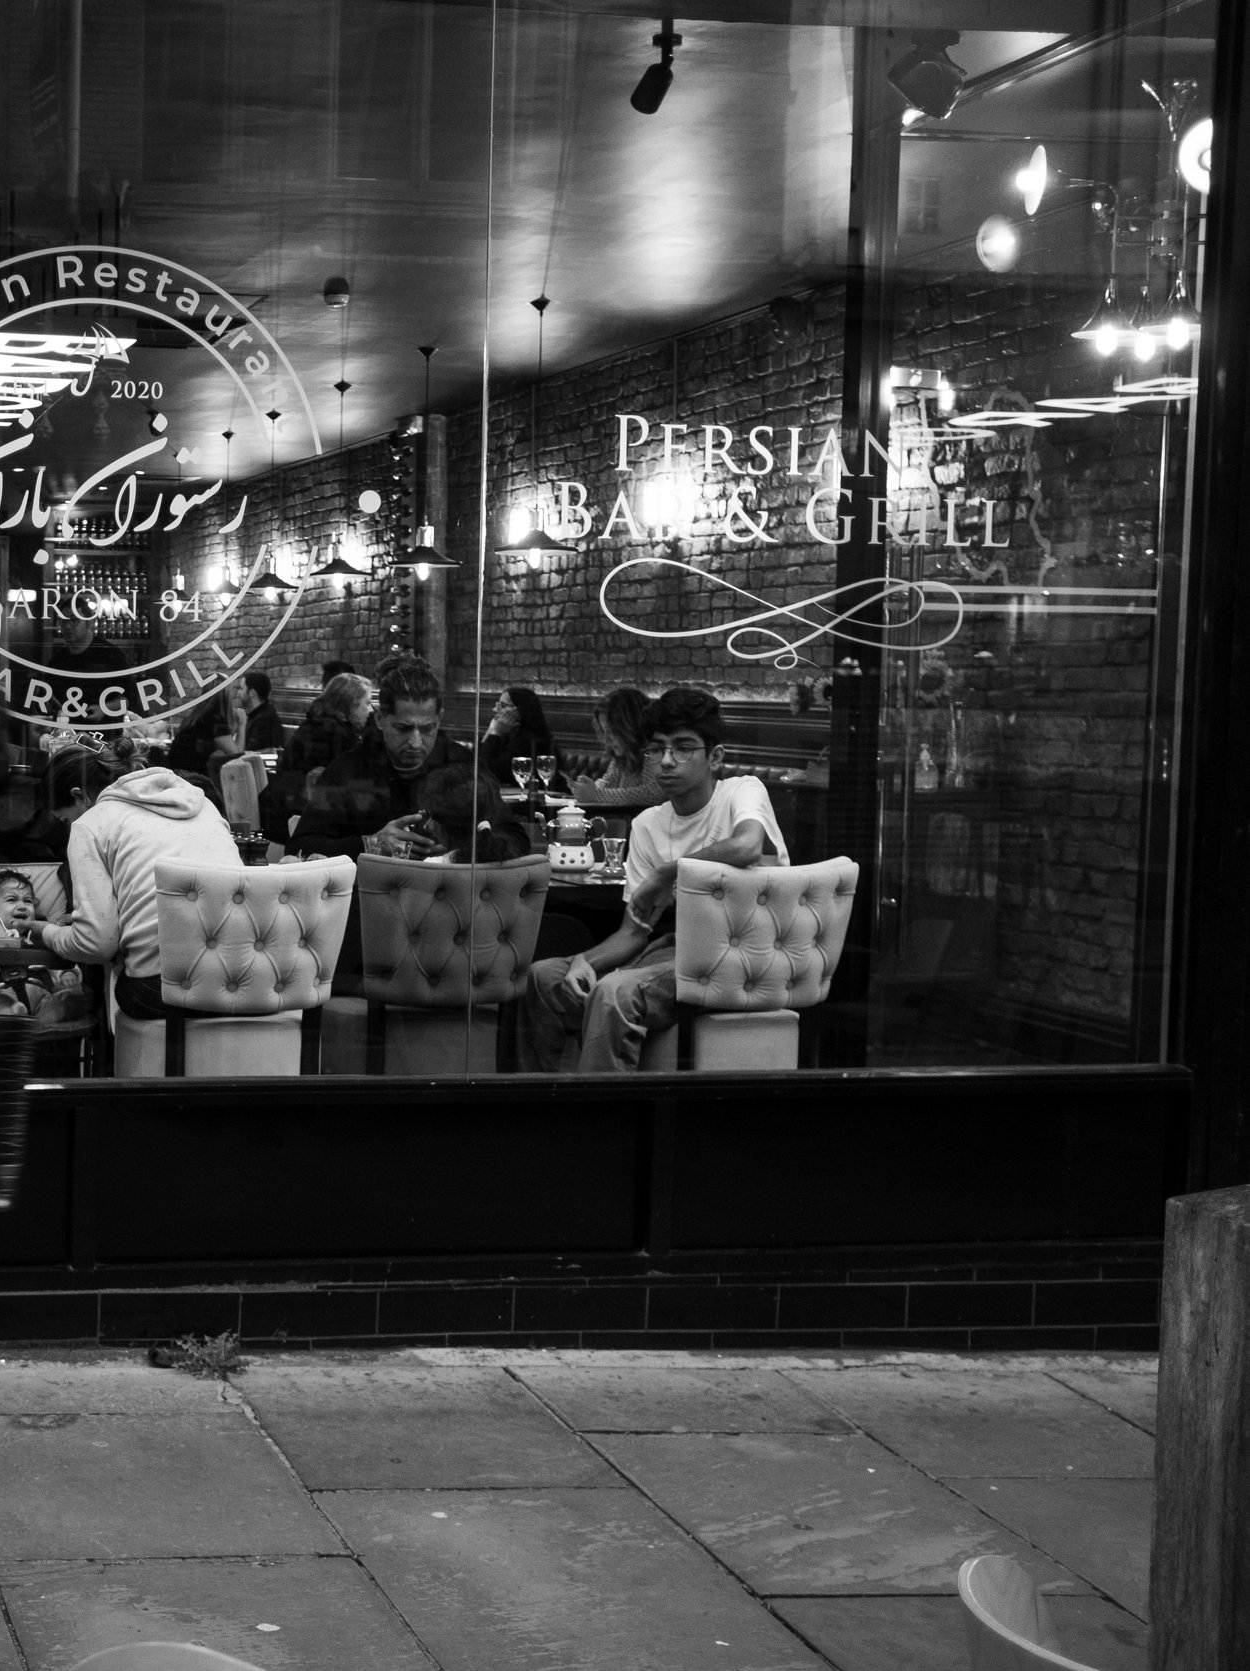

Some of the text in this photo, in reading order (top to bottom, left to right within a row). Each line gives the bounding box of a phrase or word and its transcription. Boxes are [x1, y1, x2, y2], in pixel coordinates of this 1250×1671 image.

[111, 379, 164, 400] 2020
[614, 414, 906, 478] PERSIAN
[724, 485, 778, 543] &
[805, 487, 1010, 548] GRILL
[159, 589, 203, 622] 84
